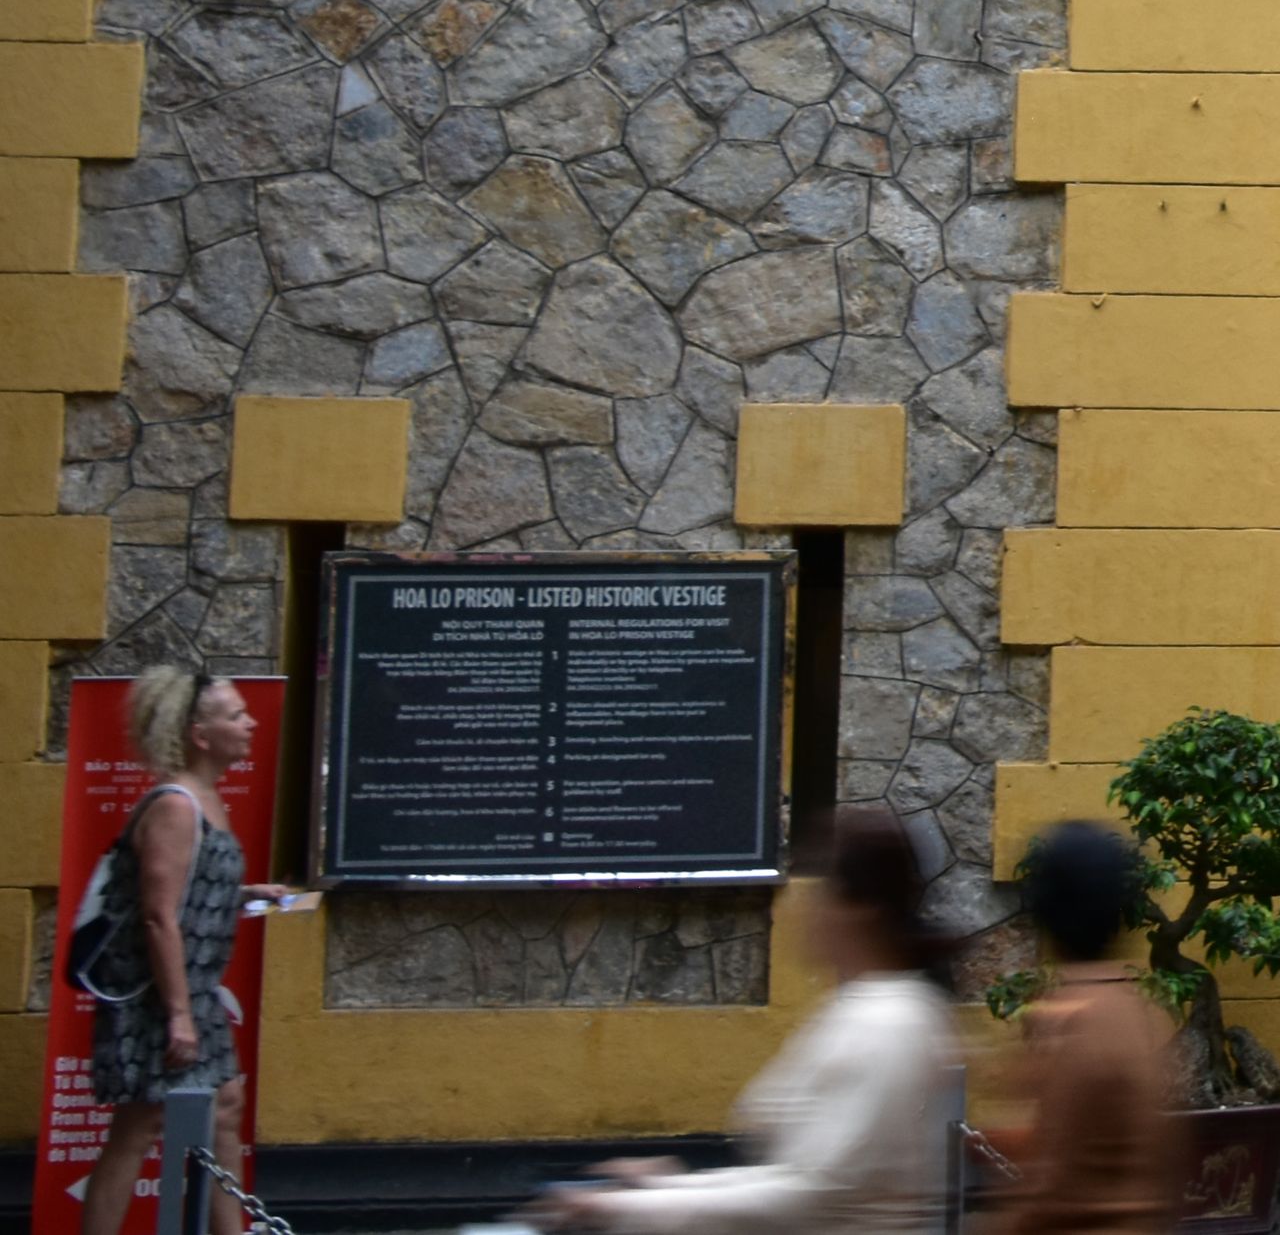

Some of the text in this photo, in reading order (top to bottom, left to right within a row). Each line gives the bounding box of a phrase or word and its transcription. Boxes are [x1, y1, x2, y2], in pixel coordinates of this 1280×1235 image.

[392, 588, 427, 609] HOA
[431, 588, 451, 608] LO
[454, 587, 515, 608] PRISON
[528, 587, 583, 608] LISTED
[585, 586, 660, 607] HISTORIC
[662, 585, 727, 606] VESTIGE
[549, 702, 558, 713] 2
[547, 736, 557, 747] 3
[547, 755, 556, 764] 4
[546, 780, 555, 791] 5
[545, 806, 554, 817] 6
